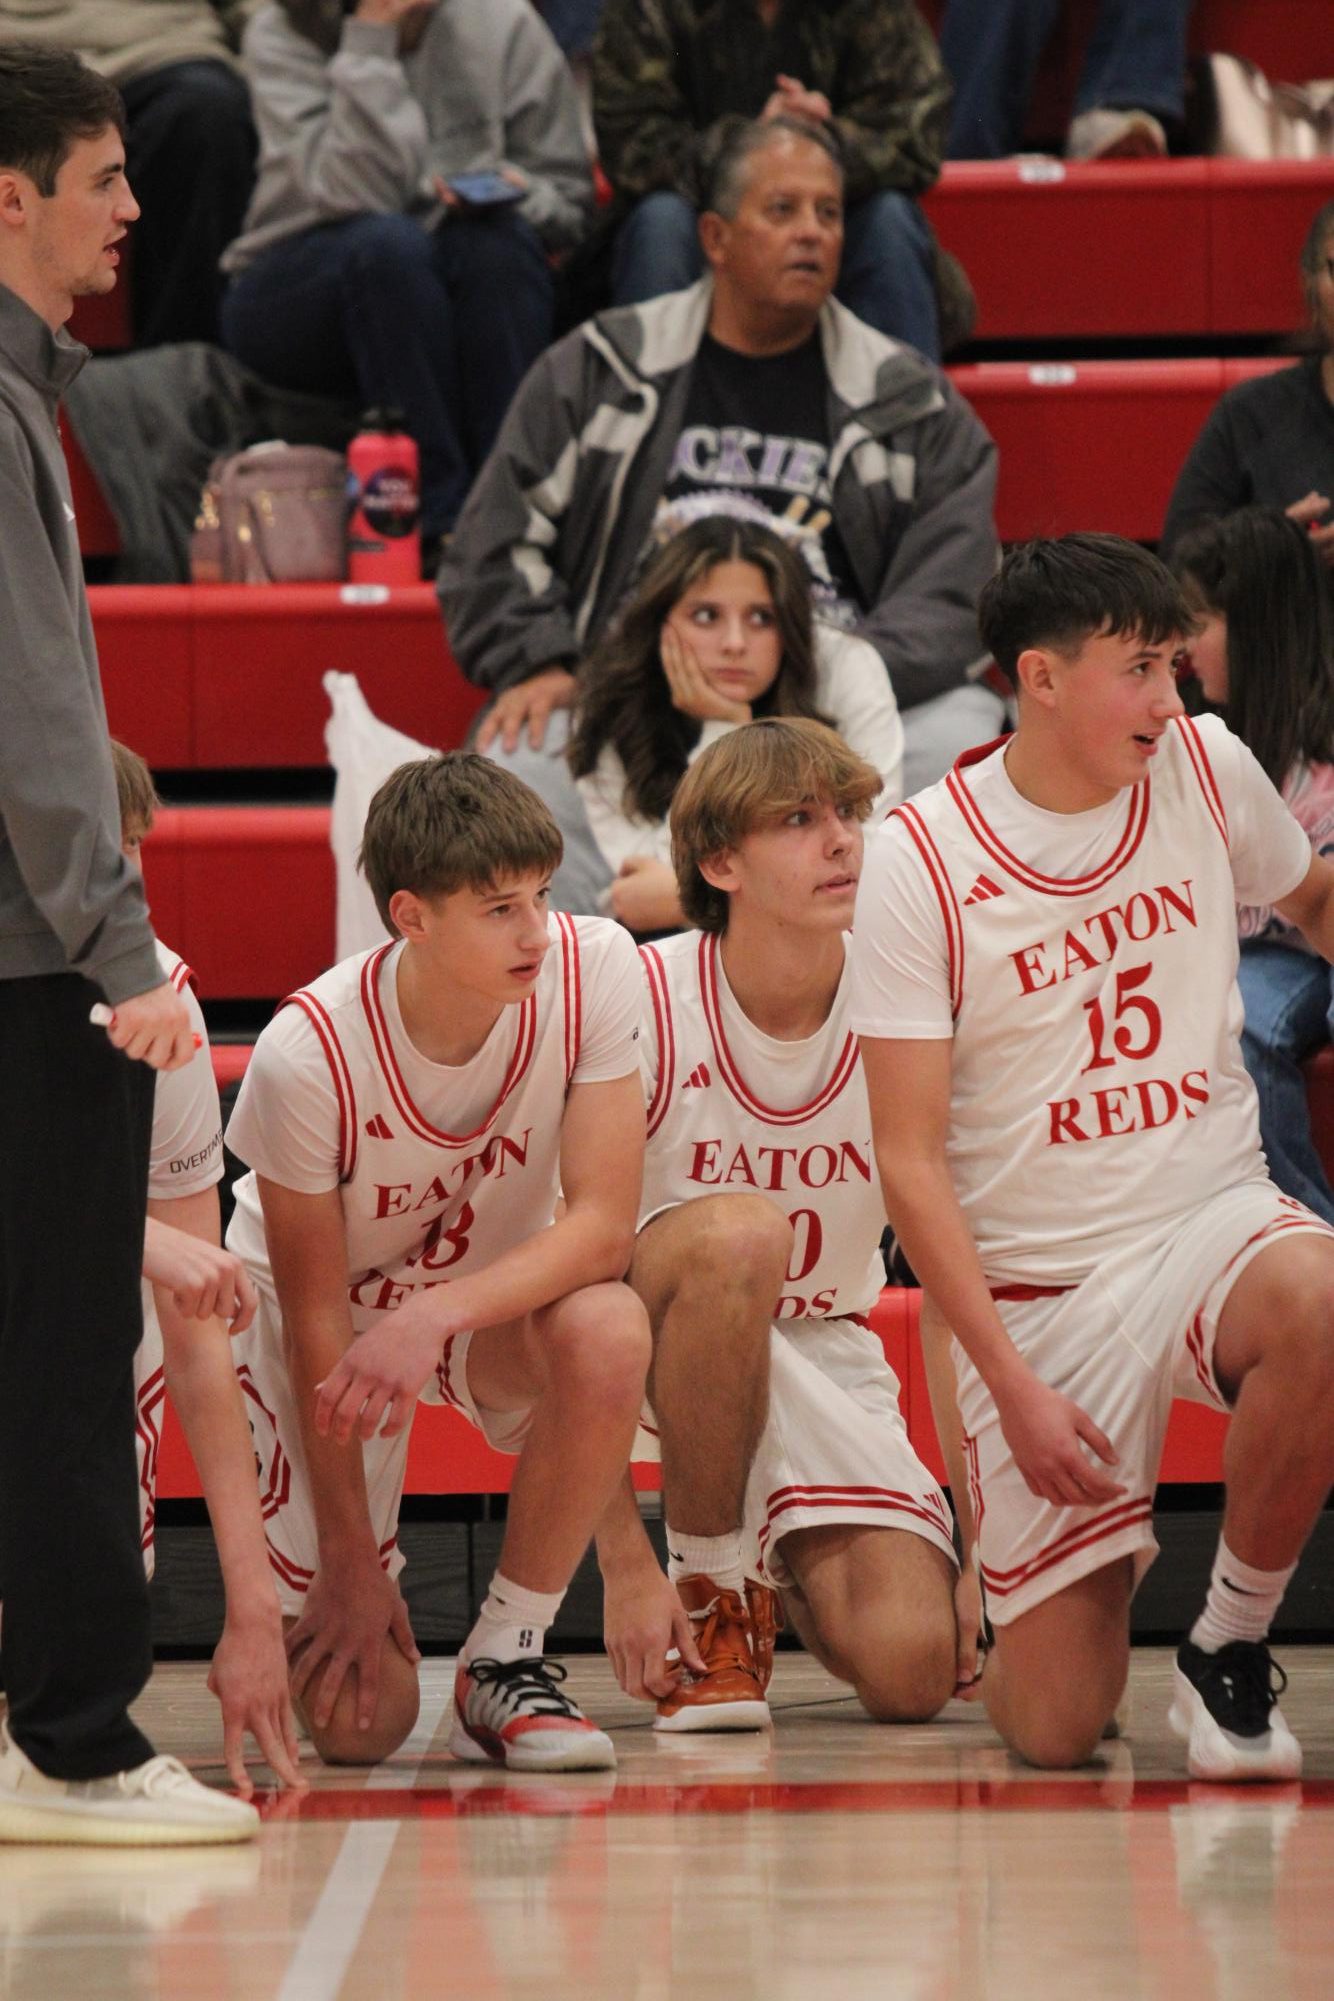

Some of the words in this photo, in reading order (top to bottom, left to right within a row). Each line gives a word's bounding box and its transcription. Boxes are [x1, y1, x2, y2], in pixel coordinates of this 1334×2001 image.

[1007, 879, 1198, 997] EATON
[1080, 961, 1162, 1076] 15
[1046, 1069, 1210, 1146] REDS
[686, 1139, 872, 1191] EATON
[773, 1288, 838, 1320] DS
